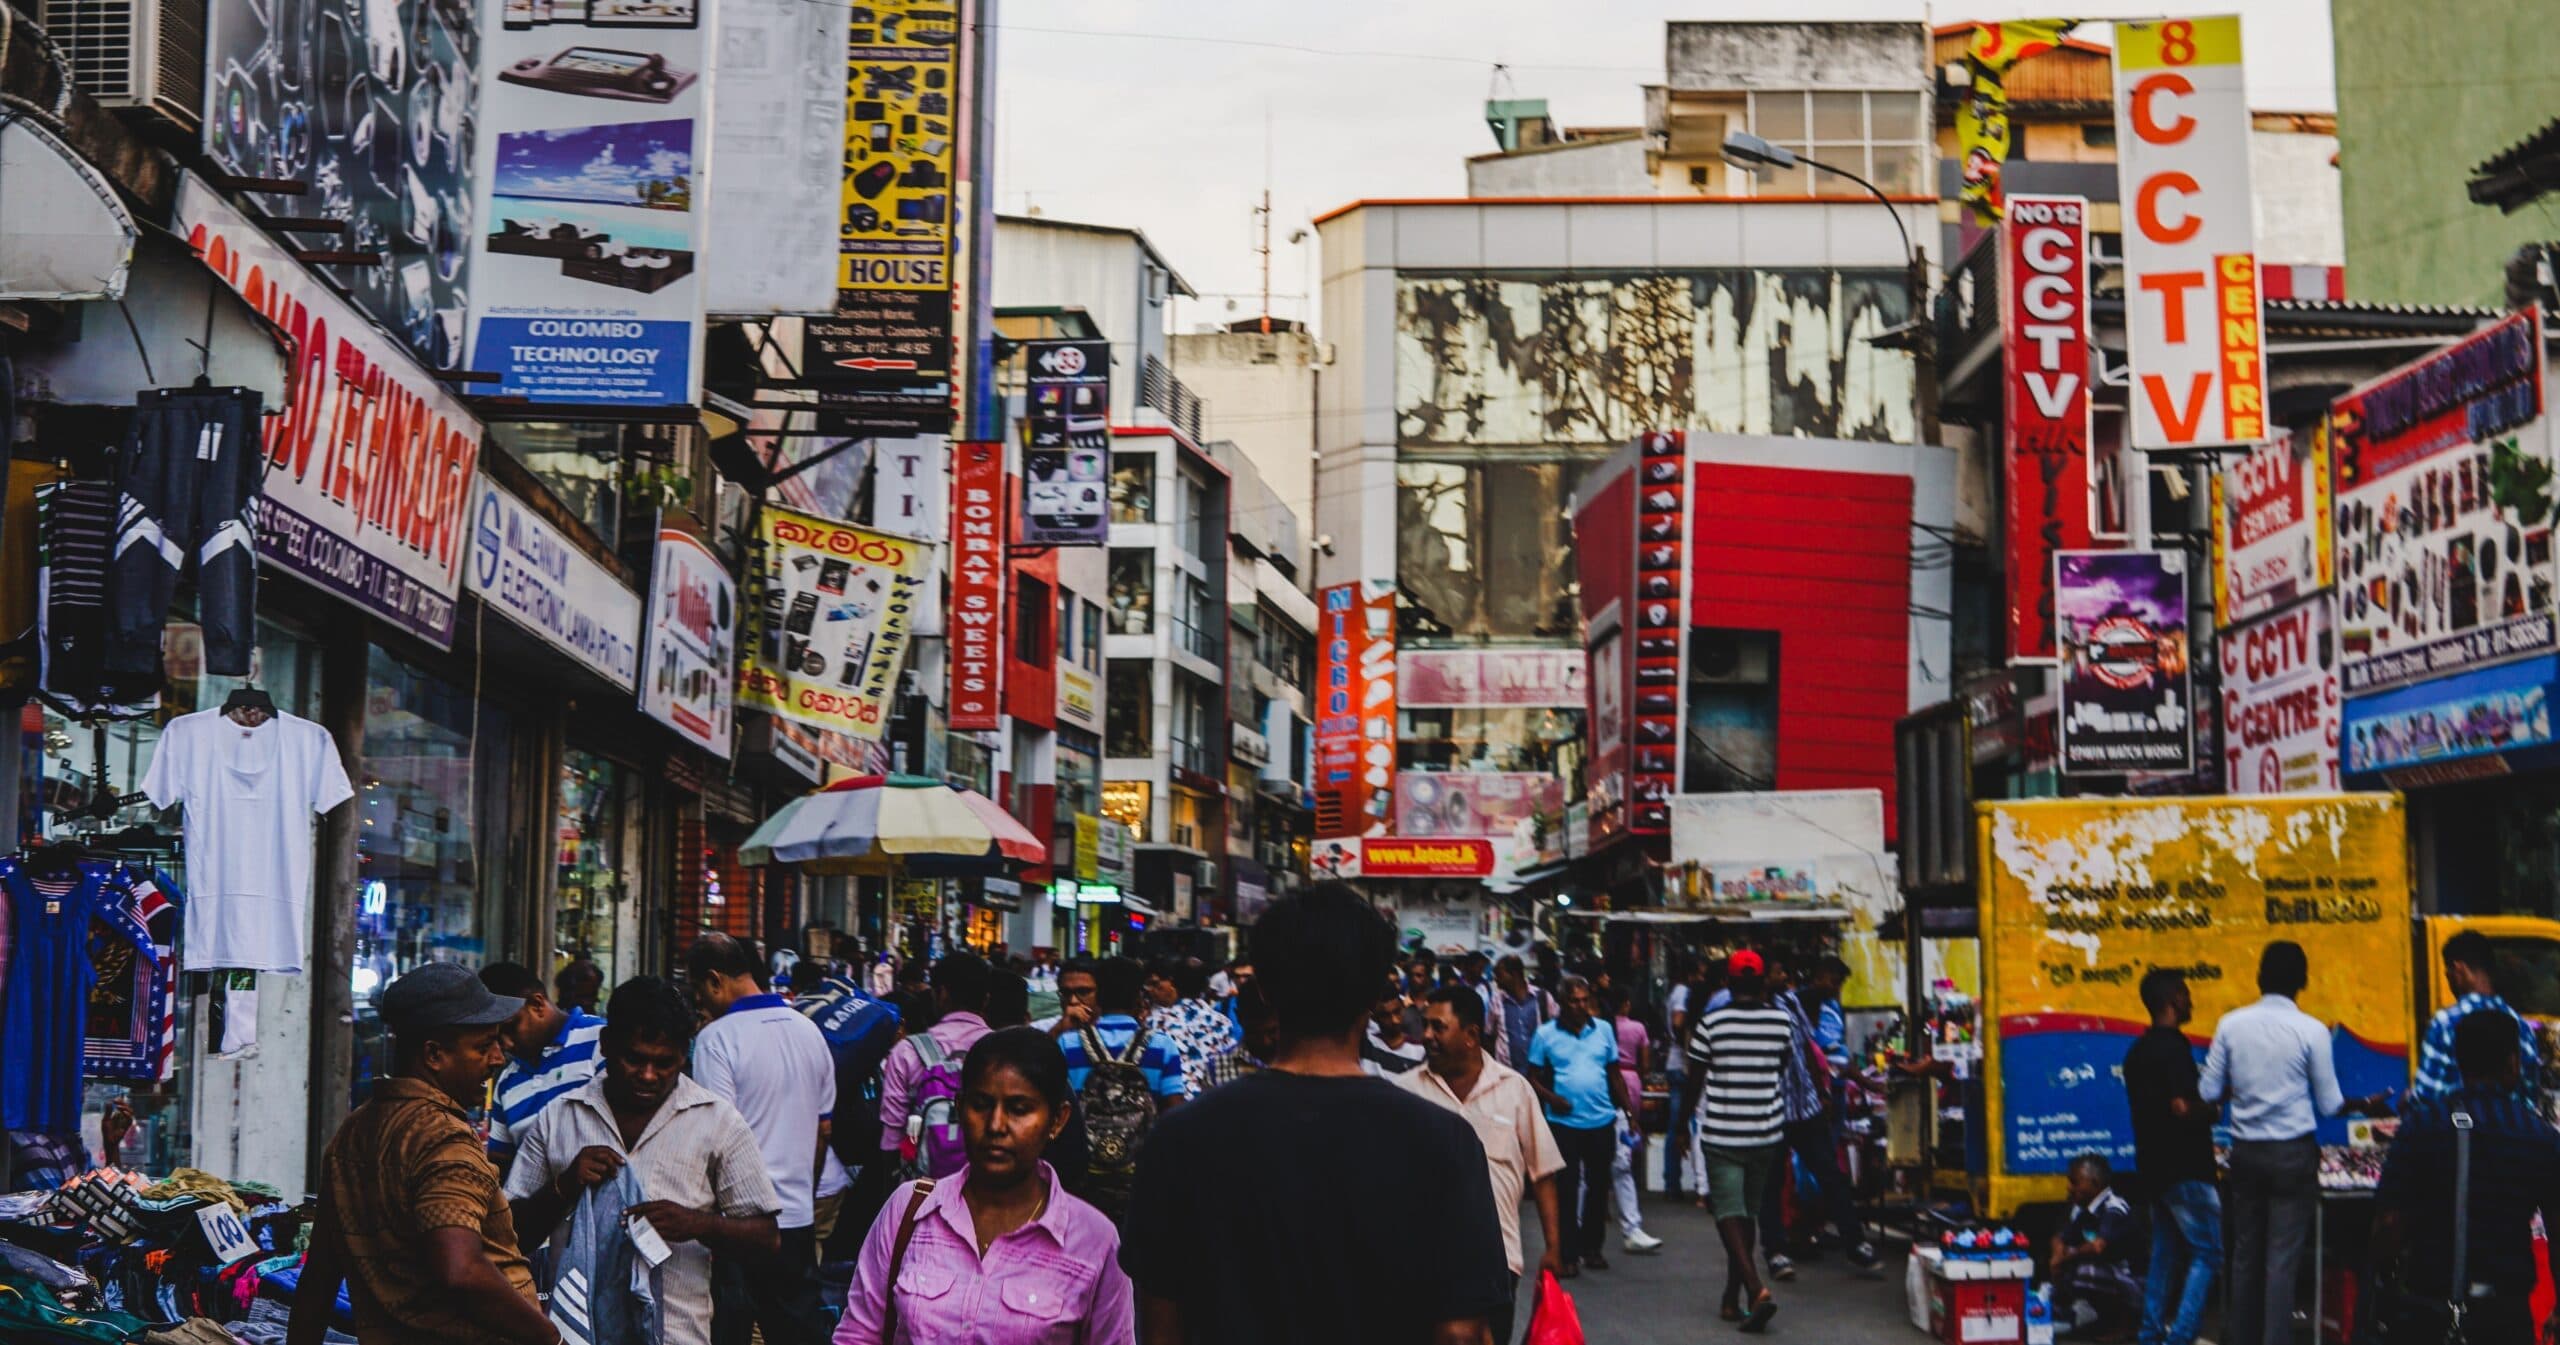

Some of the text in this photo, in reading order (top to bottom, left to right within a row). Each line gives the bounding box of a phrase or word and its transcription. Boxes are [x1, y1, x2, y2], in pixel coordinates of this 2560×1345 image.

[2159, 19, 2196, 67] 8
[2014, 203, 2080, 225] NO 12
[850, 259, 944, 284] HOUSE
[2130, 72, 2214, 444] CCTV
[528, 320, 643, 339] COLOMBO
[2022, 229, 2080, 418] CCTV
[2221, 254, 2263, 441] CENTRE
[510, 345, 660, 365] TECHNOLOGY
[320, 335, 476, 586] TECHNOLOGY
[2233, 436, 2291, 504] CCTV
[774, 520, 905, 566] කැමරා
[957, 488, 993, 693] BOMBAY SWEETS
[1326, 586, 1353, 715] MICRO
[2245, 607, 2310, 683] CCTV
[2242, 684, 2319, 750] CENTRE
[2143, 744, 2183, 760] WORKS
[1367, 844, 1478, 866] www.latest.lk
[208, 1213, 244, 1252] 100
